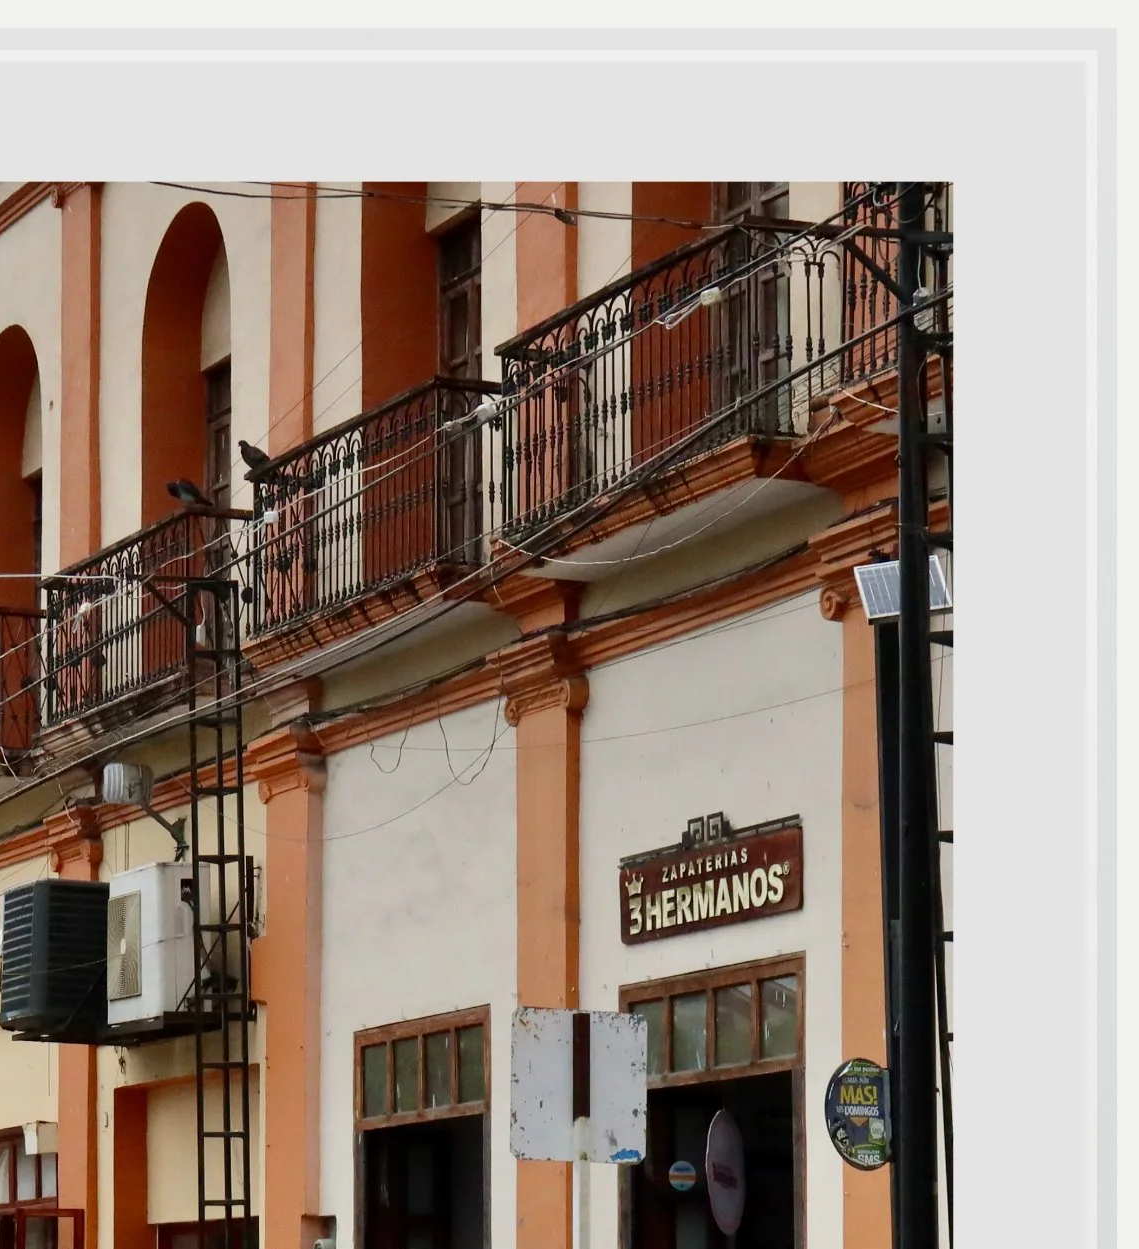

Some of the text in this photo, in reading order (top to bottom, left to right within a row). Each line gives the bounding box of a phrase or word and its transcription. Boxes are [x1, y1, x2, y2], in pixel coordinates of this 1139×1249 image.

[662, 847, 749, 884] ZAPATERIAS
[629, 895, 643, 935] 3
[844, 1106, 879, 1117] DOMINGOS
